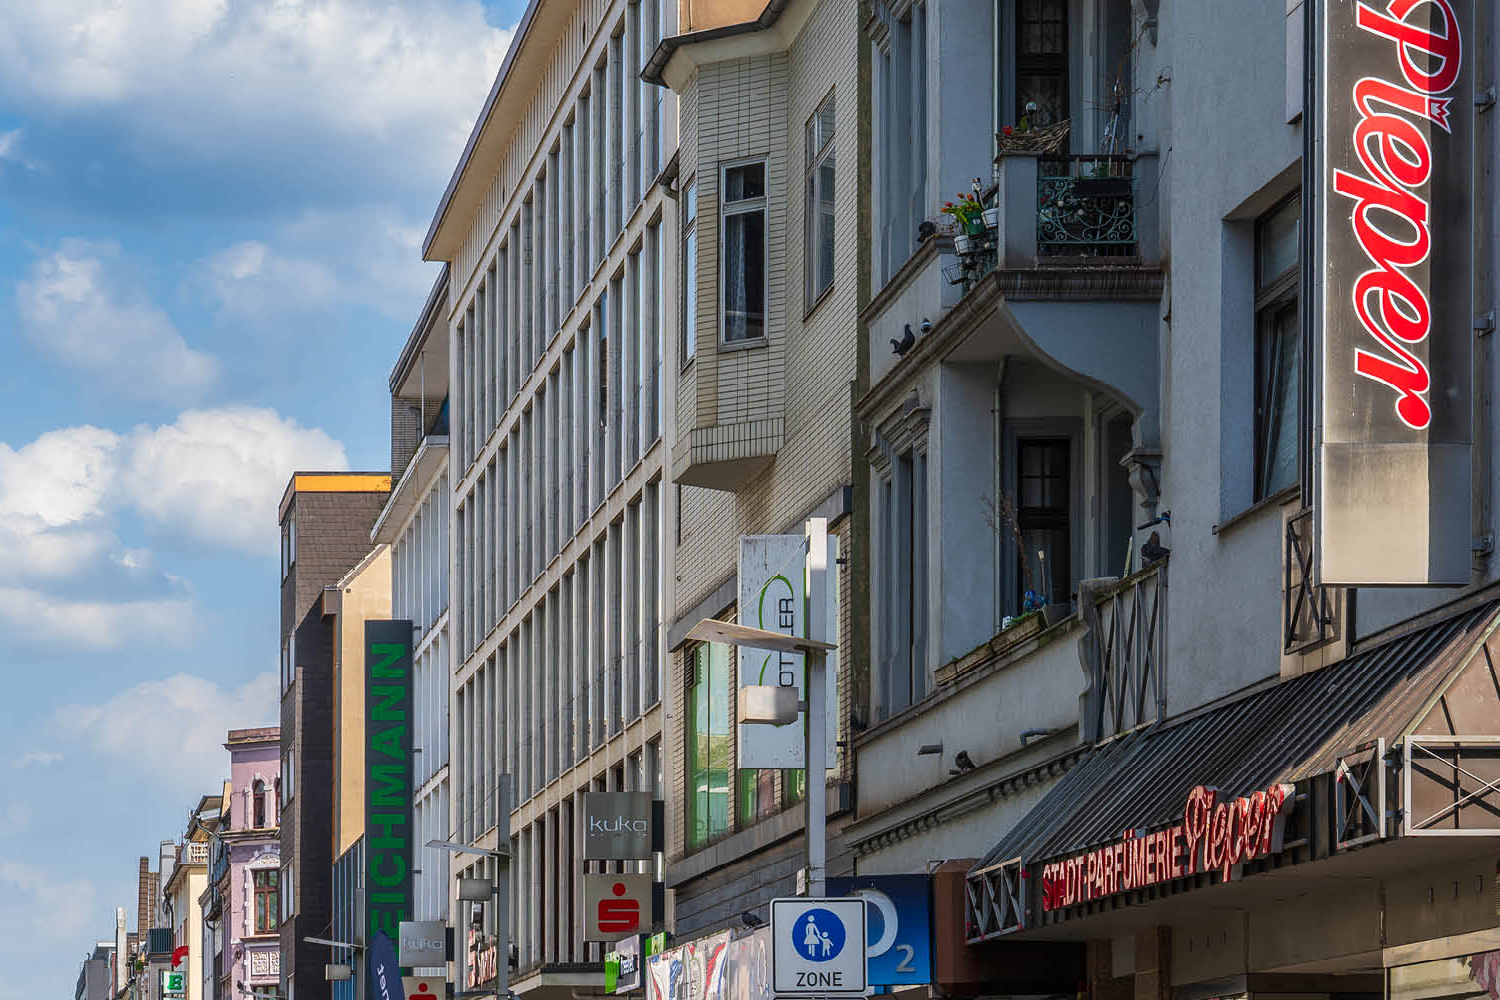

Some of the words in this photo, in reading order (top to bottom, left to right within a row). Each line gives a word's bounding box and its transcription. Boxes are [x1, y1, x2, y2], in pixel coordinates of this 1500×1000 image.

[1339, 0, 1463, 431] Pieper
[370, 642, 406, 965] EICHMANN
[590, 816, 648, 833] kuka
[1185, 784, 1288, 883] Pieper
[796, 972, 843, 987] ZONE
